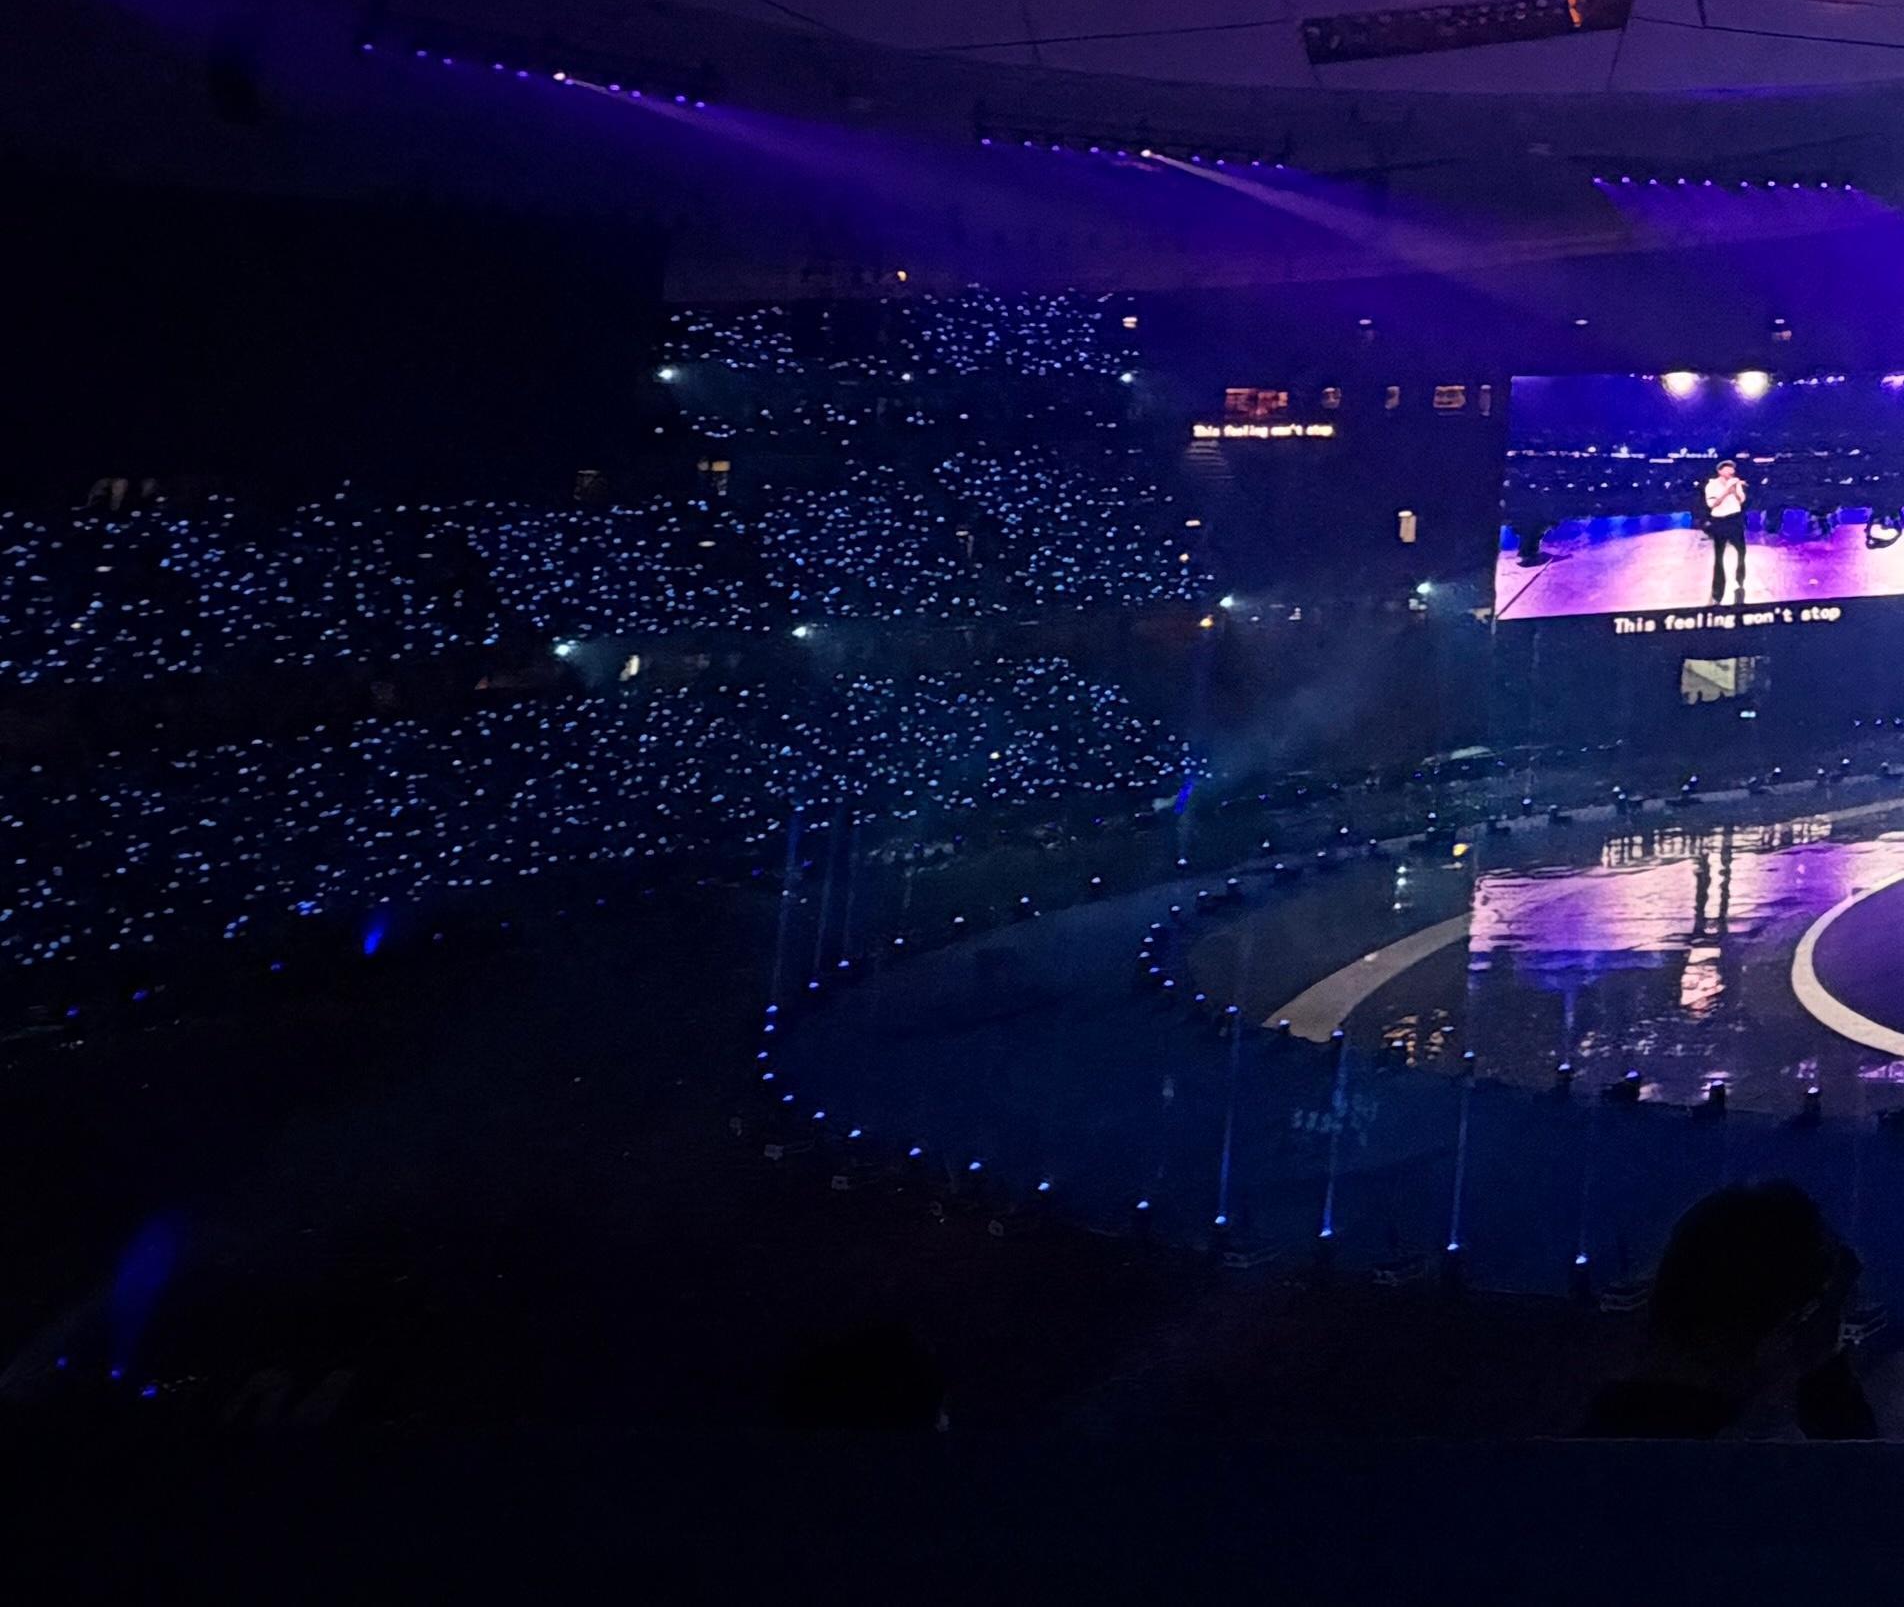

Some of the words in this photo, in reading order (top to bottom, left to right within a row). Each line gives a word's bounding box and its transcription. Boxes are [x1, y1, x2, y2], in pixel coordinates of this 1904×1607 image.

[1613, 617, 1656, 634] This
[1664, 613, 1736, 630] feeling
[1800, 606, 1841, 622] stop
